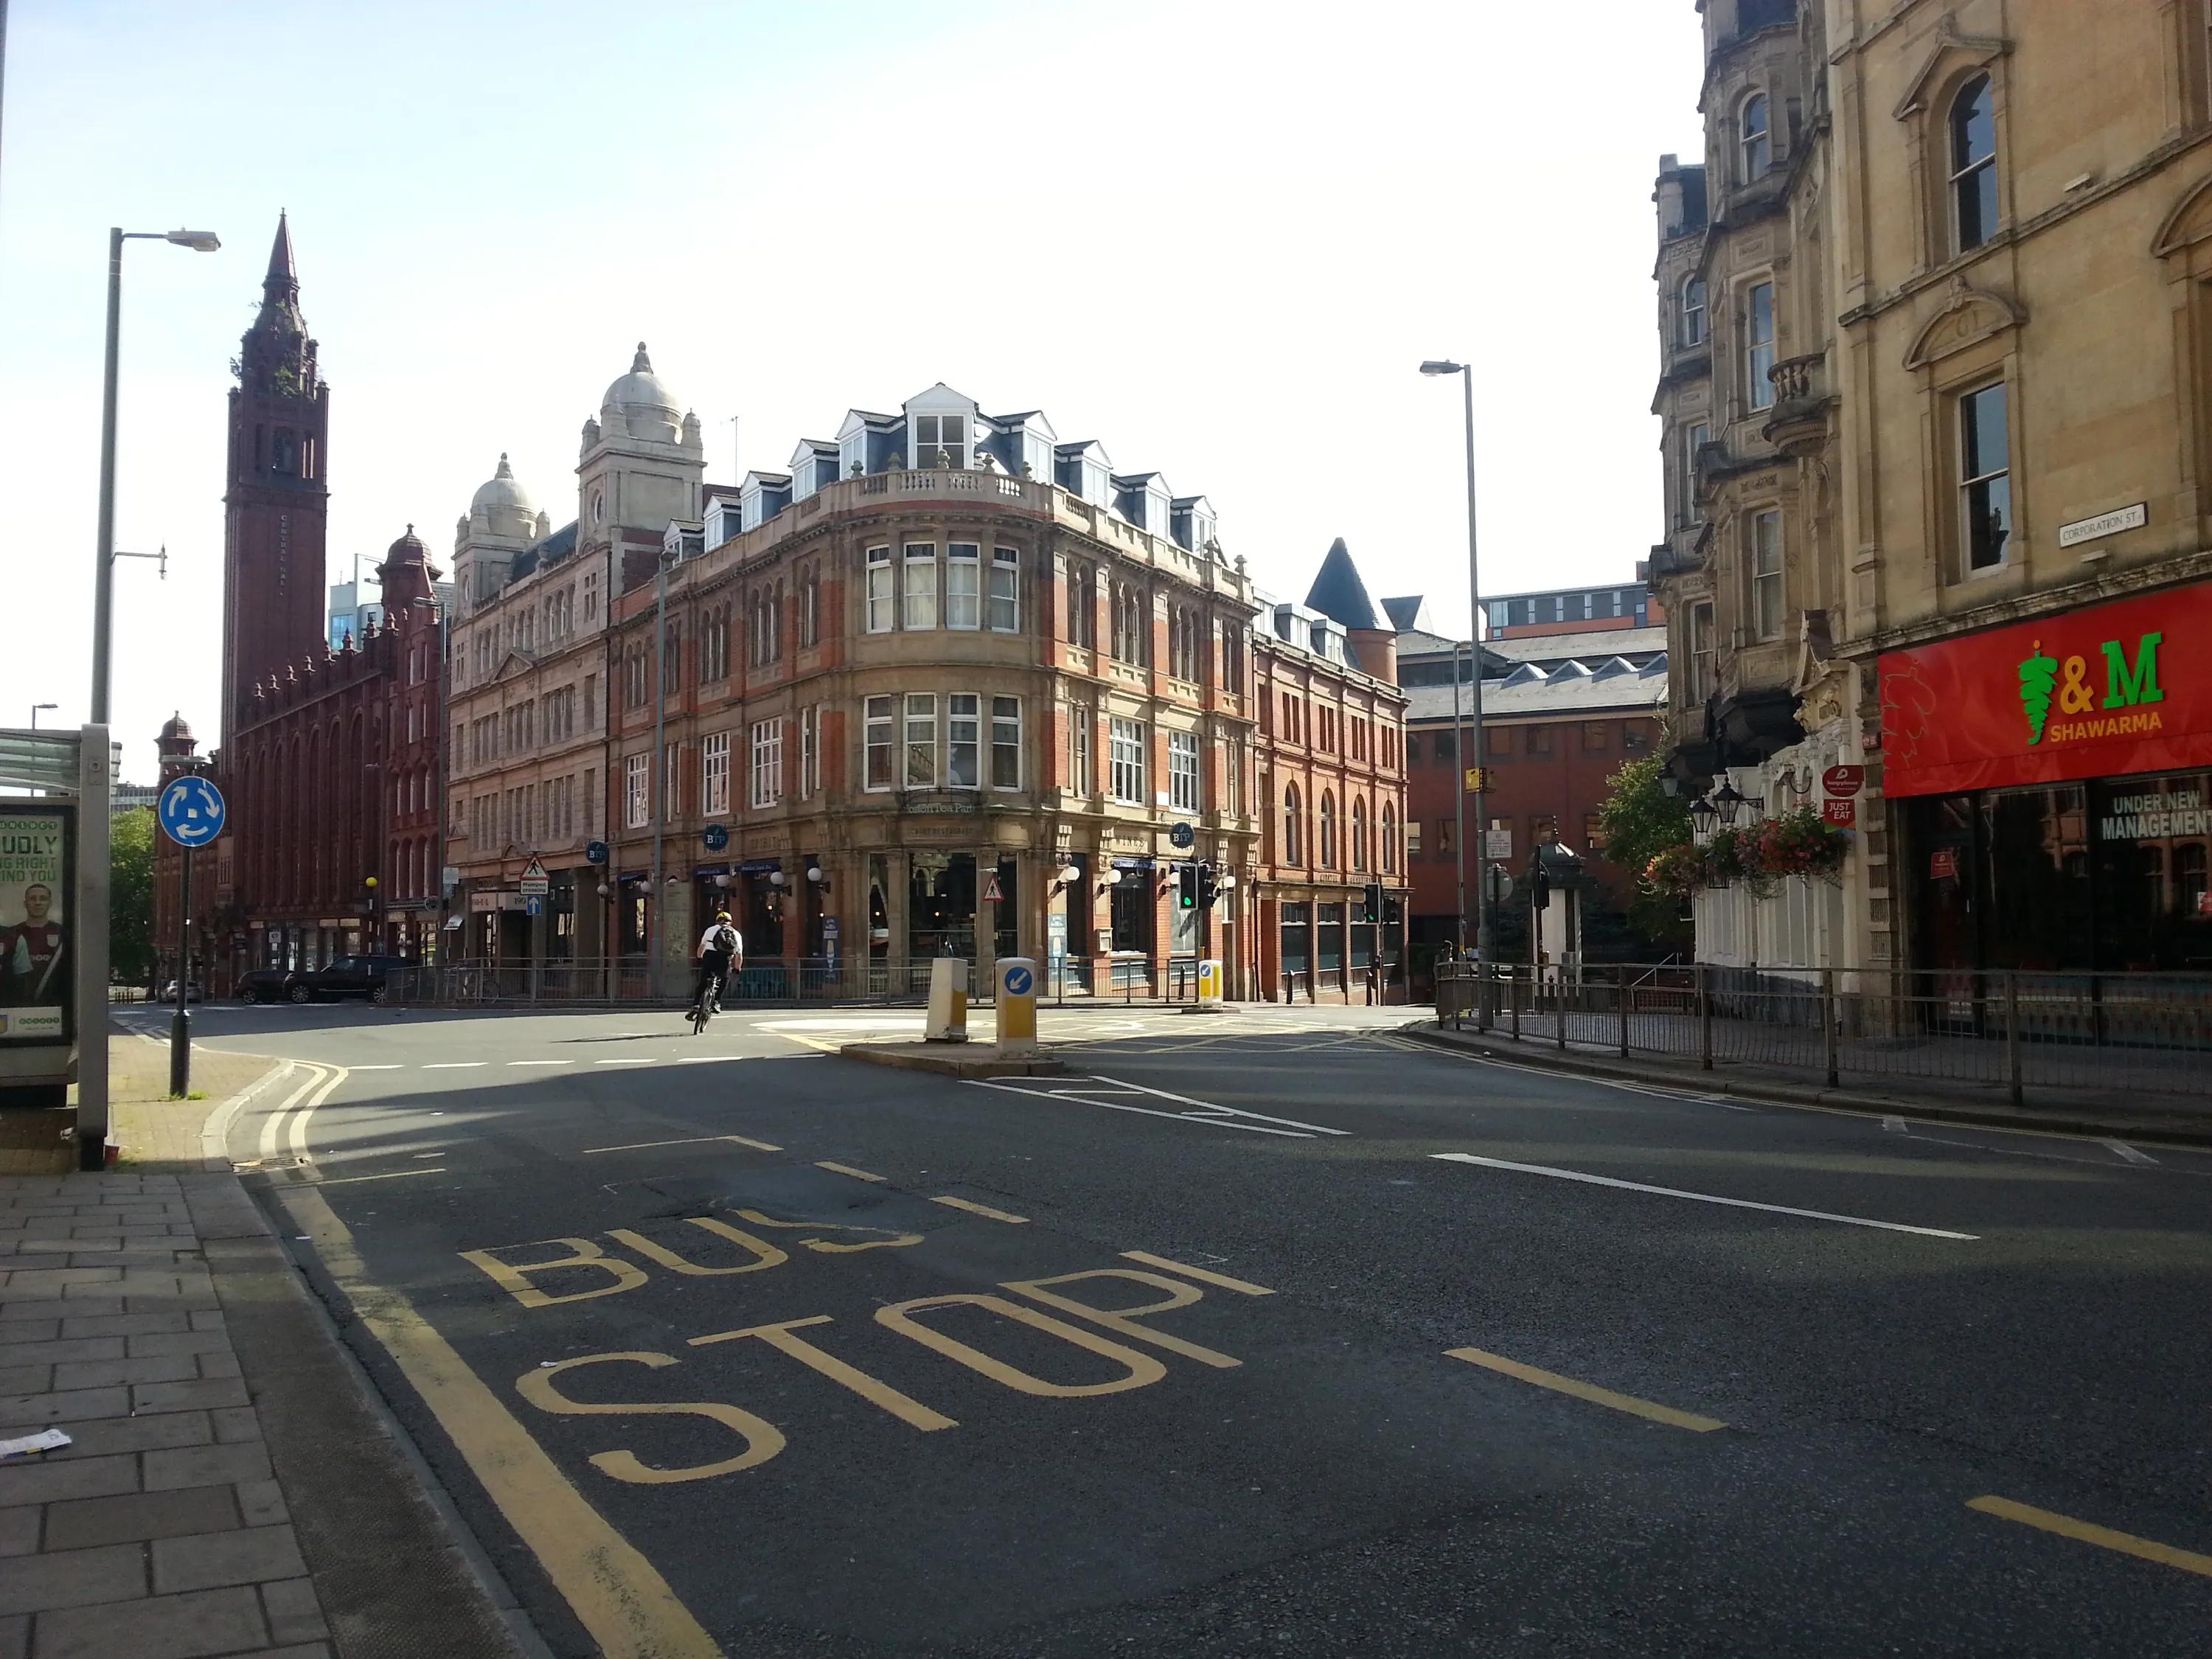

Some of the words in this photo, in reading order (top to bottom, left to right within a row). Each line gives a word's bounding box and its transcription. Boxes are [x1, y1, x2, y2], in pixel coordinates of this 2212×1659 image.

[2063, 515, 2123, 540] CORPORATION
[2126, 512, 2136, 524] ST
[2101, 631, 2163, 709] M
[2051, 712, 2163, 742] SHAWARMA
[935, 802, 953, 813] Tea
[1829, 802, 1850, 812] JUST
[2114, 795, 2163, 815] UNDER
[2167, 790, 2200, 810] NEW
[1834, 811, 1851, 820] EAT
[707, 835, 726, 844] BTP
[1116, 835, 1144, 848] WINES
[1173, 832, 1191, 843] BTP
[16, 858, 57, 869] RIGHT
[30, 871, 56, 882] YOU
[459, 1209, 925, 1308] BUS
[515, 1268, 1244, 1485] STOP
